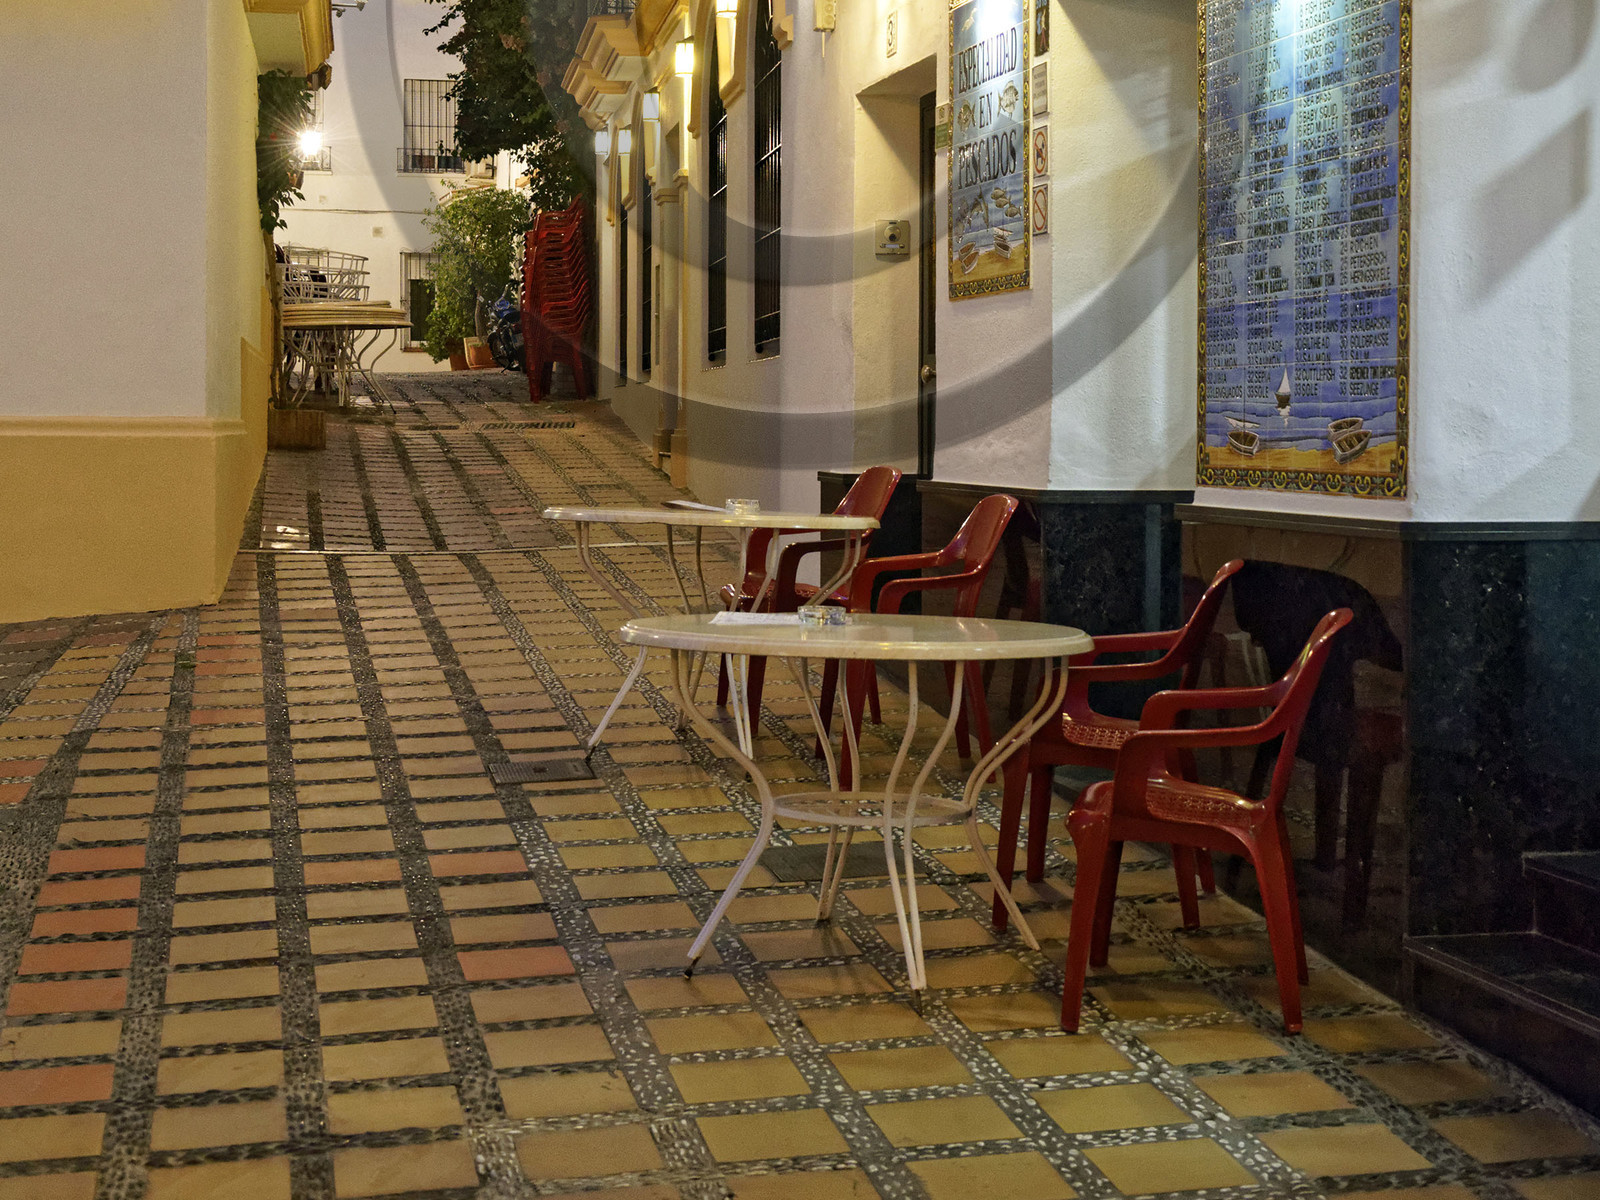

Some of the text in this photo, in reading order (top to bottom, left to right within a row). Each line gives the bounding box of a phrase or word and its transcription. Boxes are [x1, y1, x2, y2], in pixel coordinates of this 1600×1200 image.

[1305, 9, 1330, 29] ROSADA
[887, 19, 894, 47] 3
[1305, 27, 1325, 46] ANGLER
[1327, 22, 1339, 39] FISH
[958, 26, 1018, 95] ESPECIALIDAD
[1304, 43, 1323, 61] SWORD
[1324, 39, 1336, 55] FISH
[1304, 60, 1318, 76] TUNA
[1321, 55, 1333, 71] FISH
[979, 91, 993, 130] EN
[1303, 107, 1317, 123] BABY
[1320, 102, 1336, 118] SQUID
[1303, 115, 1338, 136] RED MULLET
[958, 128, 1018, 190] PESCADOS
[1302, 244, 1321, 259] SKATE
[1350, 235, 1378, 252] ROCHEN
[1350, 250, 1386, 268] PETERSFISCH
[1350, 331, 1389, 347] GOLDBRASSE
[1254, 385, 1268, 398] SOLE
[1302, 383, 1317, 396] SOLE
